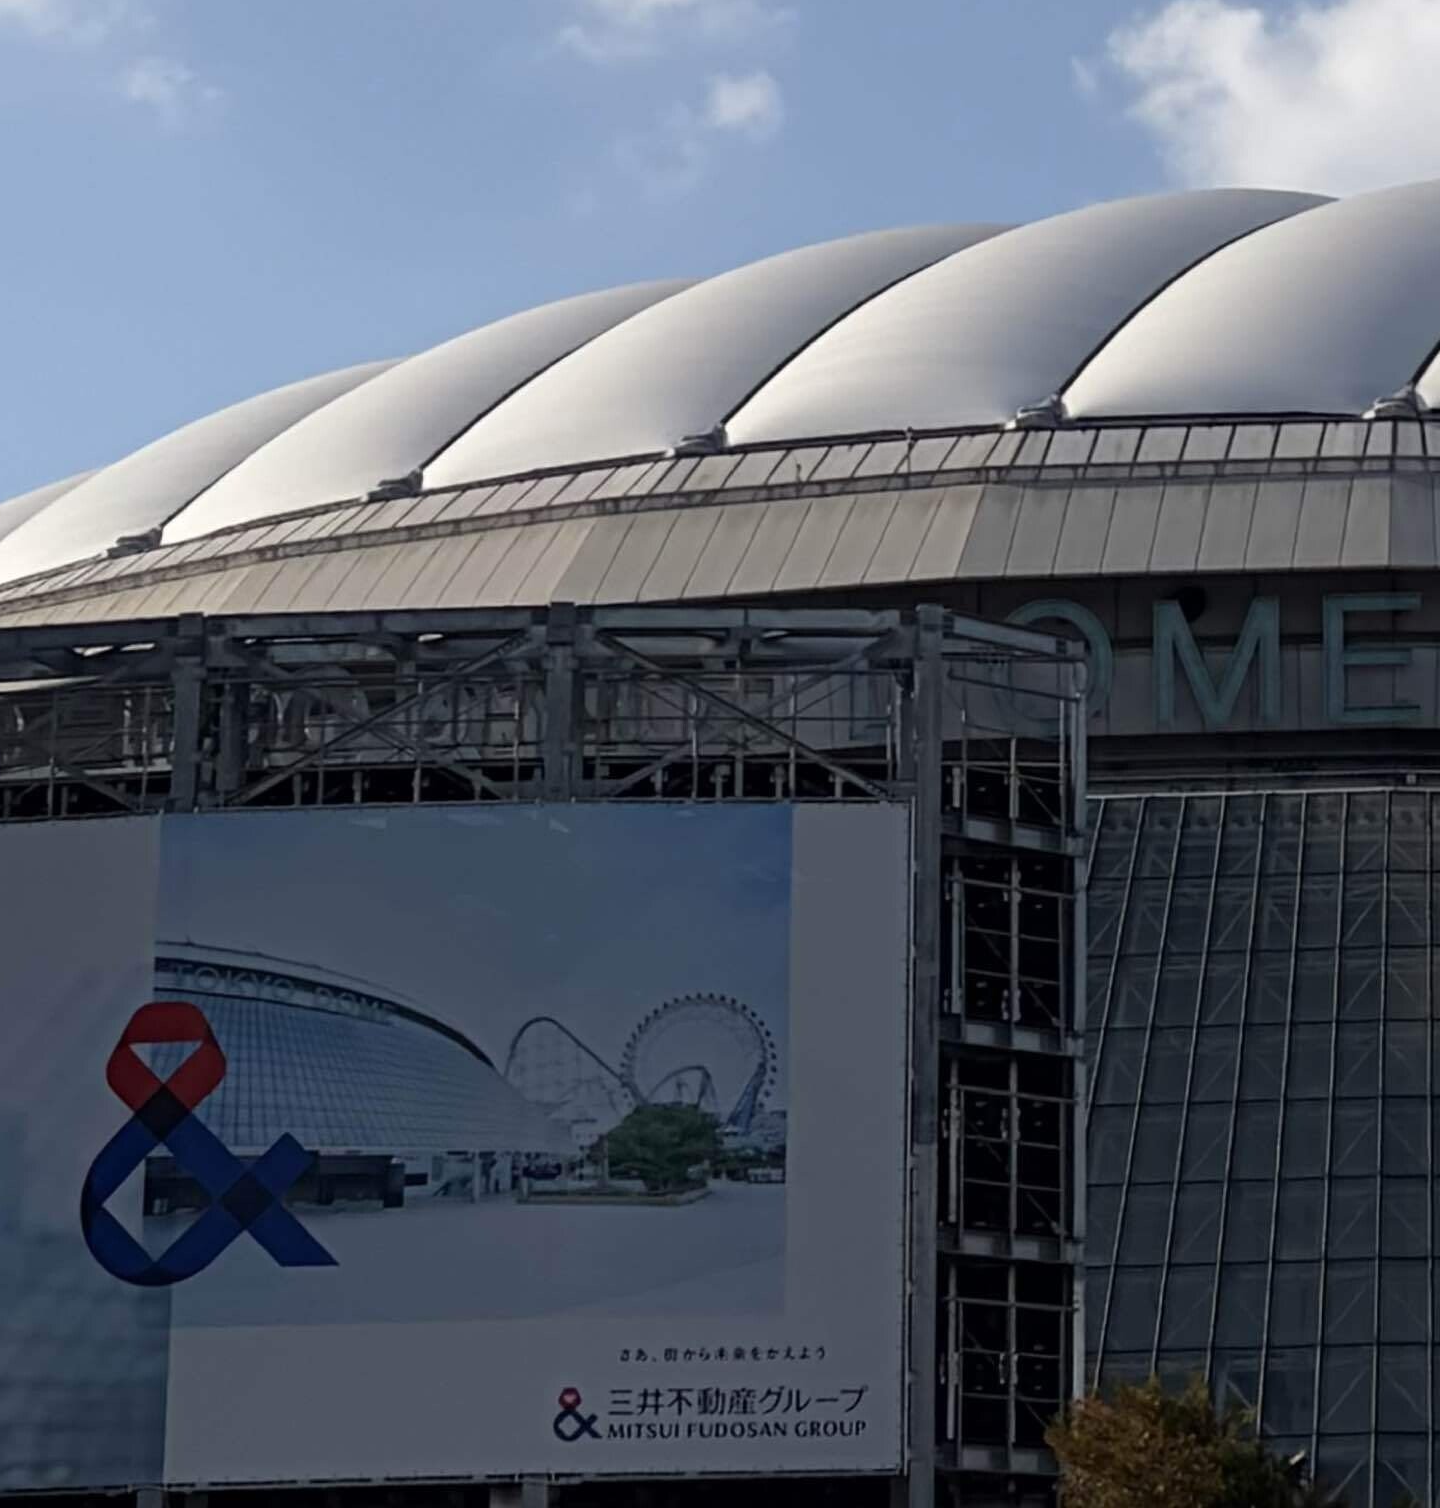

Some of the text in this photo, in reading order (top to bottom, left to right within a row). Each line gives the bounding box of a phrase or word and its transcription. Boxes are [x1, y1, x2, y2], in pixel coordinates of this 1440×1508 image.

[176, 963, 297, 1002] TOKYO
[608, 1385, 869, 1417] 三井不動産グループ
[607, 1420, 867, 1439] MITSUI FUDOSAN GROUP
